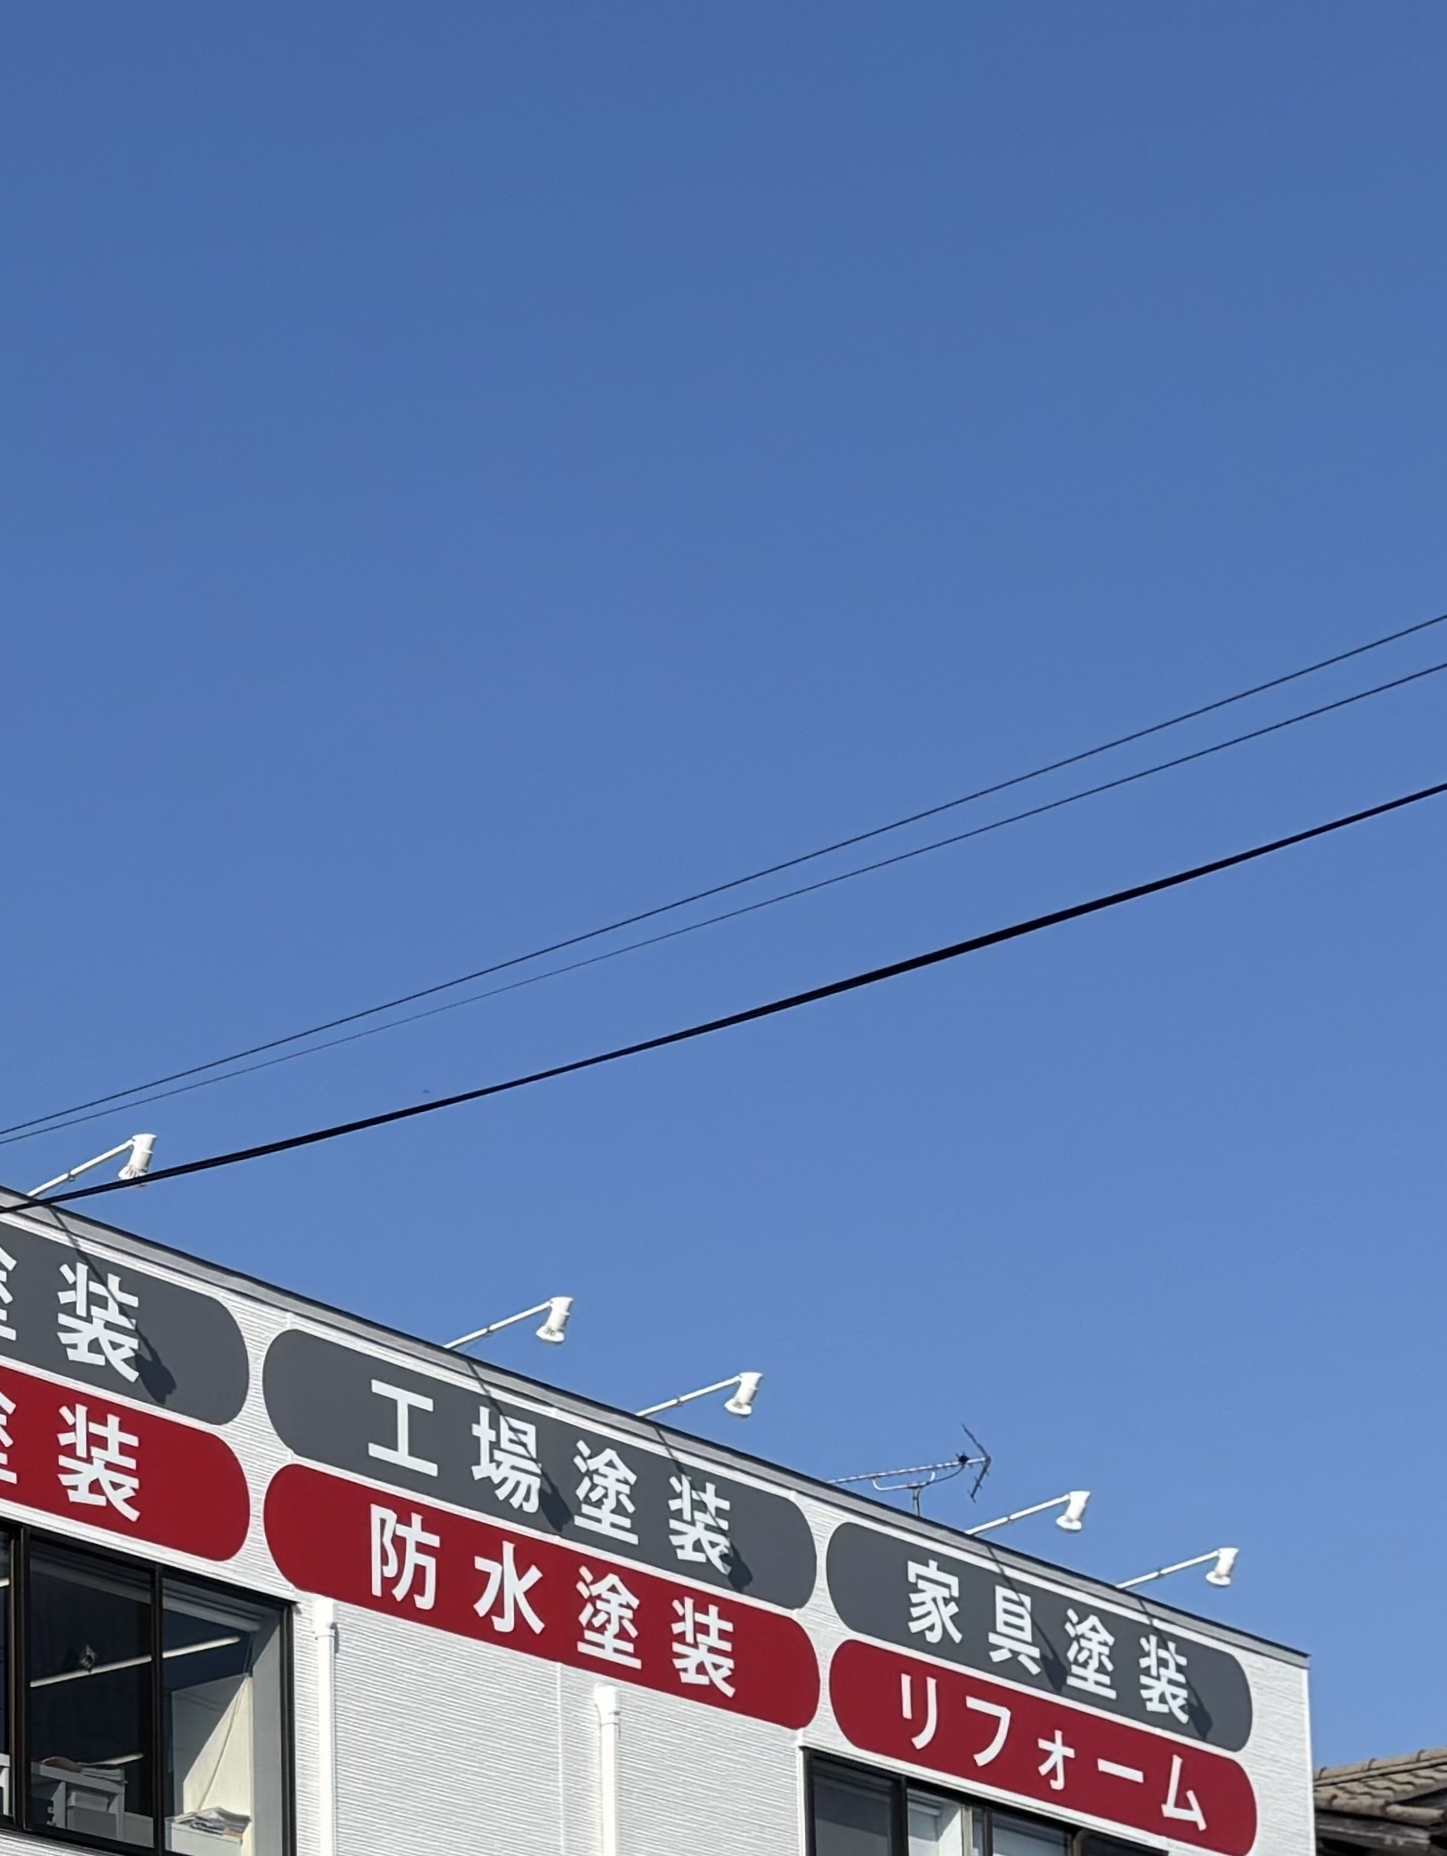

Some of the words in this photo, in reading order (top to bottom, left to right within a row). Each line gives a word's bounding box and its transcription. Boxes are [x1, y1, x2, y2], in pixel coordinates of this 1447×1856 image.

[368, 1379, 732, 1577] 工場塗装
[370, 1504, 736, 1698] 防水塗装
[906, 1560, 1190, 1725] 家具塗装
[901, 1673, 1207, 1832] リフォーム
